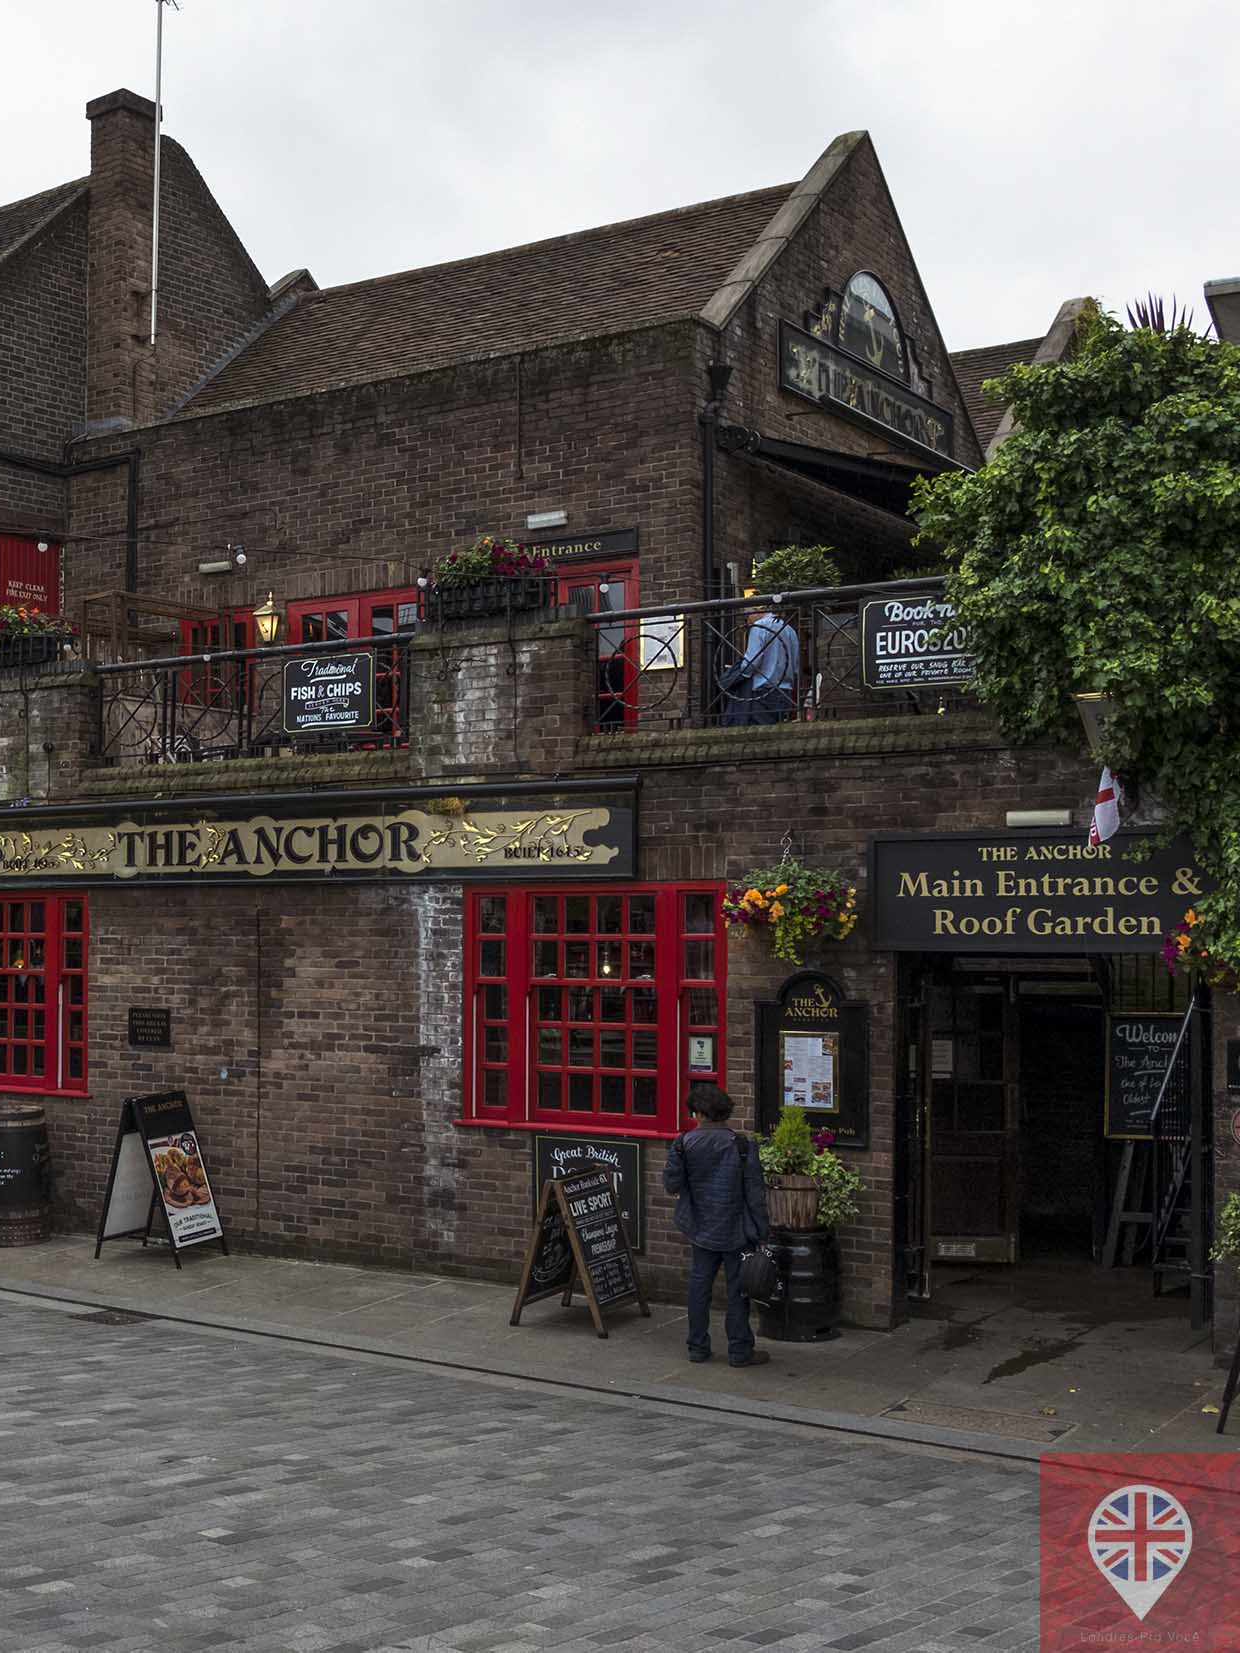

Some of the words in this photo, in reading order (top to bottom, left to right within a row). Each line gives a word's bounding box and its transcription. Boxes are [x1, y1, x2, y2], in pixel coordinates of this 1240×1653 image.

[884, 600, 936, 622] Book
[290, 685, 316, 701] FISH
[317, 684, 325, 698] &
[326, 681, 362, 698] CHIPS
[116, 829, 201, 869] THE
[217, 821, 422, 867] ANCHOR
[978, 847, 1018, 862] THE
[1024, 844, 1112, 861] ANCHOR
[896, 870, 984, 898] Main
[995, 870, 1160, 897] Entrance
[1170, 866, 1204, 896] &
[932, 907, 1022, 936] Roof
[1026, 906, 1163, 936] Garden
[784, 1007, 839, 1018] ANCHOR
[792, 997, 815, 1007] THE
[1115, 1023, 1188, 1043] Welcom
[550, 1146, 584, 1166] Great
[584, 1145, 622, 1168] British
[569, 1199, 588, 1217] LIVE
[588, 1191, 613, 1211] SPORT
